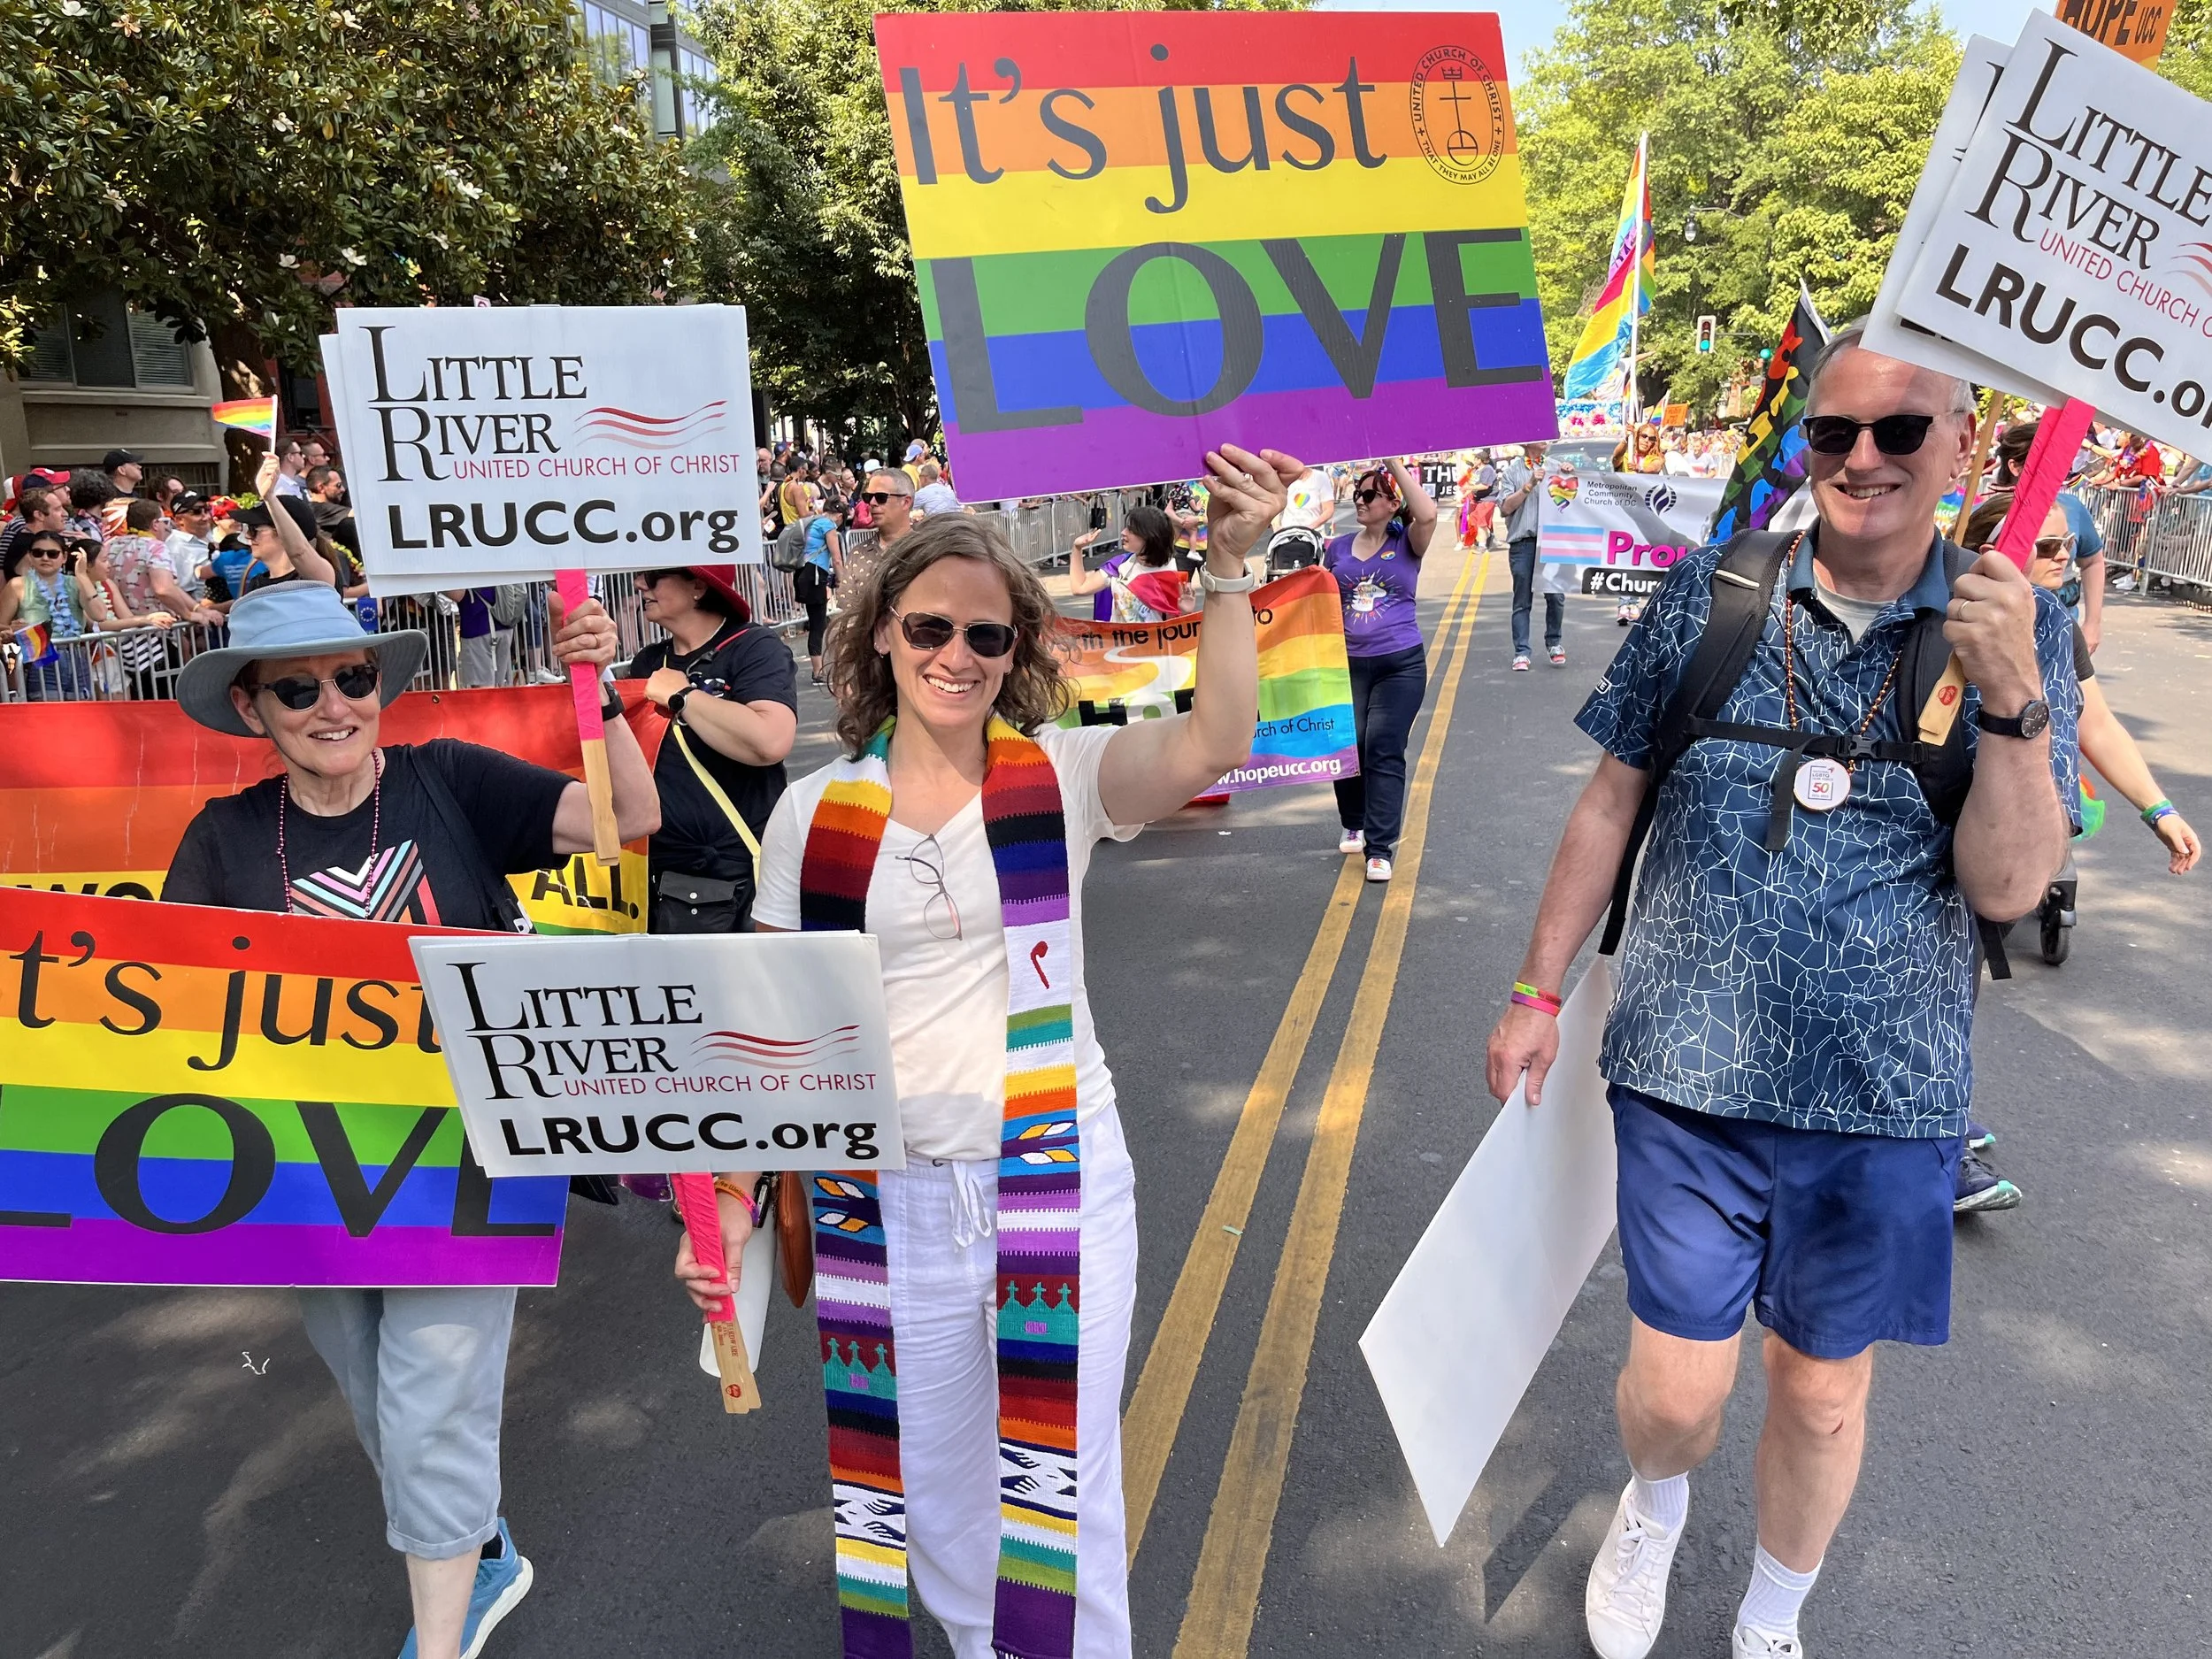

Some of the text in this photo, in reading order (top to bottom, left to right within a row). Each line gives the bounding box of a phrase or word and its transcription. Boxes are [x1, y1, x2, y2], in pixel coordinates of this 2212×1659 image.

[2134, 6, 2162, 44] UCC
[1412, 49, 1502, 122] UNITED CHURCH OF CHRIST
[898, 43, 1388, 214] It’s just
[1422, 140, 1439, 164] THAT
[1439, 165, 1458, 180] THEY
[1479, 166, 1490, 177] ALL
[1489, 156, 1496, 167] BE
[2005, 38, 2212, 227] LITTLE
[1964, 128, 2160, 270] RIVER
[2039, 228, 2112, 280] UNITED
[2116, 270, 2200, 328] CHURCH
[930, 227, 1544, 434] LOVE
[359, 326, 588, 403] LITTLE
[370, 406, 562, 482] RIVER
[454, 454, 739, 480] UNITED CHURCH OF CHRIST
[1584, 497, 1613, 506] Church
[1587, 481, 1637, 491] Metropolitan
[1588, 489, 1633, 500] Community
[389, 500, 740, 554] LRUCC.org
[1112, 629, 1149, 648] the
[1280, 718, 1294, 733] of
[1297, 718, 1335, 733] Christ
[1812, 783, 1829, 794] 50
[531, 856, 639, 919] ALL.
[188, 937, 442, 1072] just
[446, 962, 703, 1033] LITTLE
[466, 1033, 680, 1100] RIVER
[565, 1072, 877, 1096] UNITED CHURCH OF CHRIST
[0, 1093, 556, 1237] OV
[500, 1112, 880, 1160] LRUCC.org
